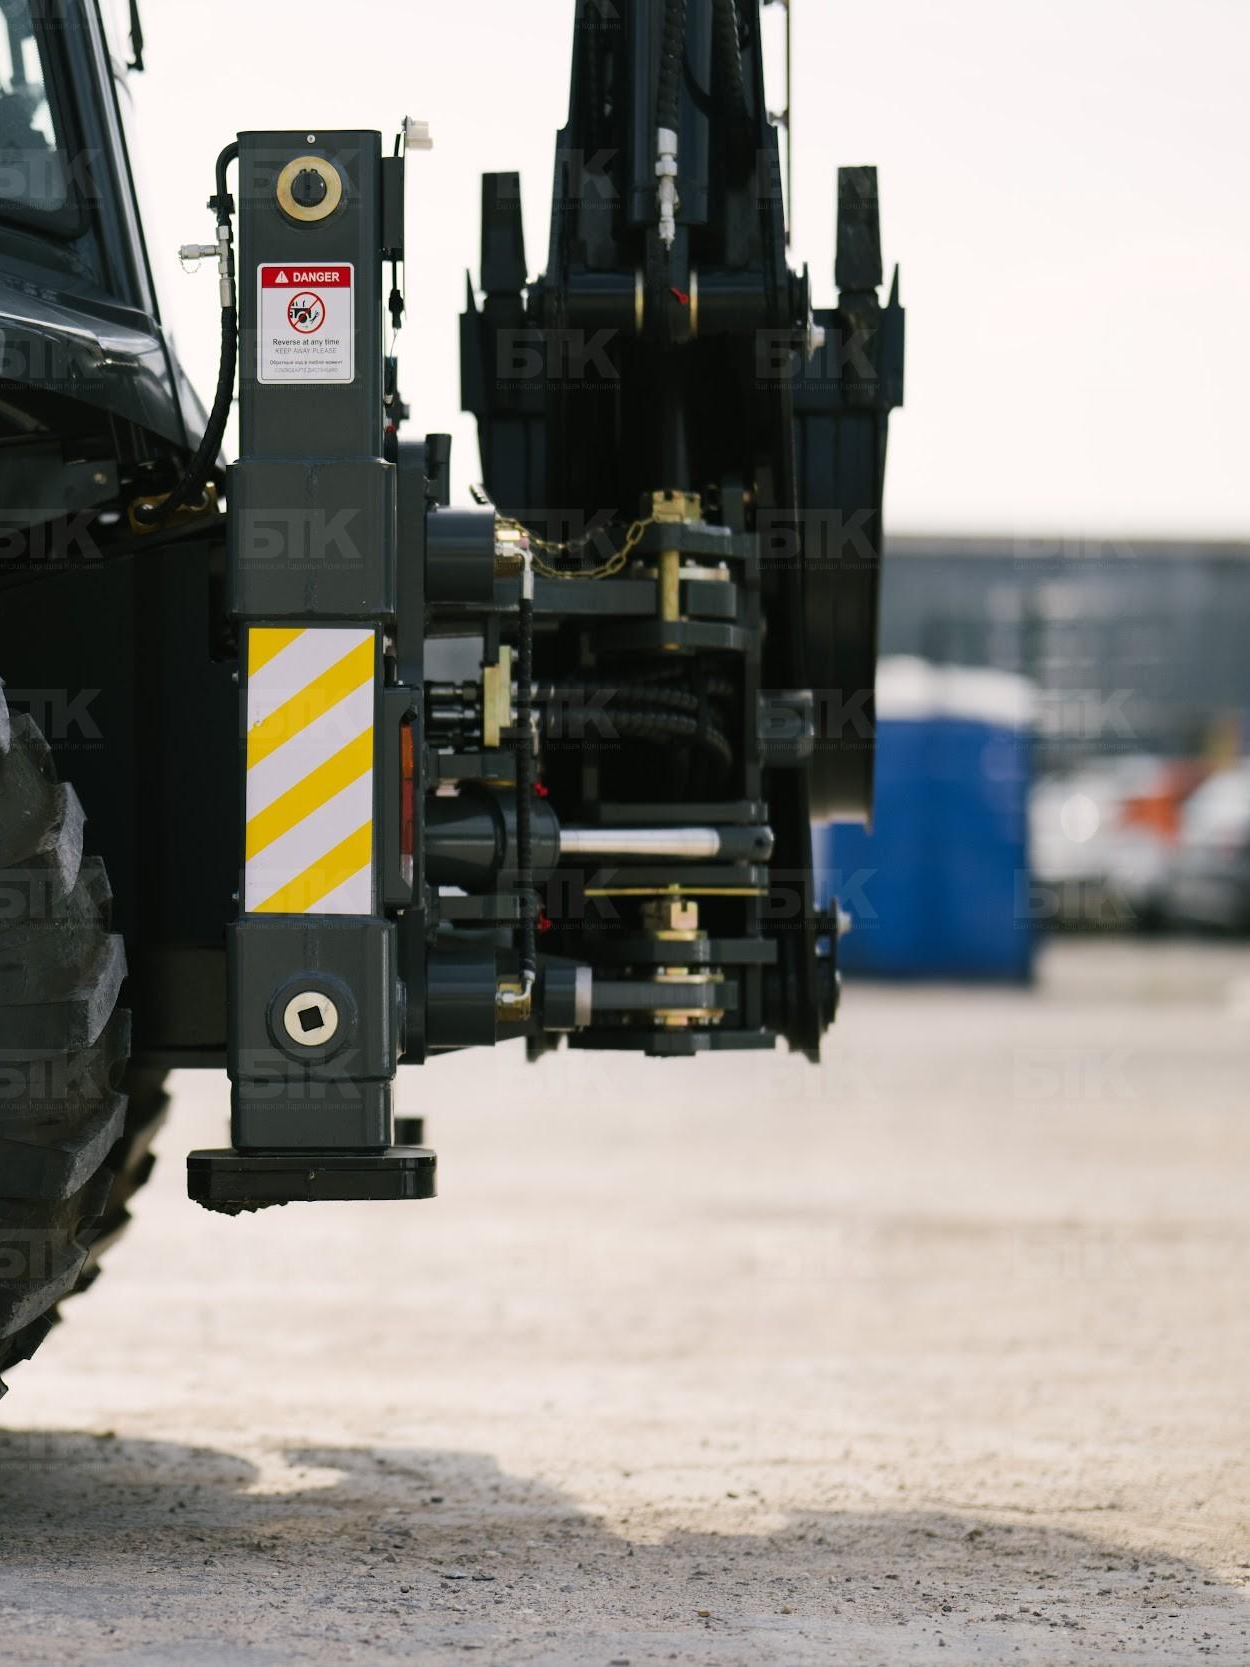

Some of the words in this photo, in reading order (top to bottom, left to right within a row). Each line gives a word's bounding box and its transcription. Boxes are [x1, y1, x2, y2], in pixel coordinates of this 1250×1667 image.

[293, 272, 340, 282] DANGER
[272, 338, 301, 346] Reverse
[311, 339, 323, 347] any
[324, 338, 340, 346] time
